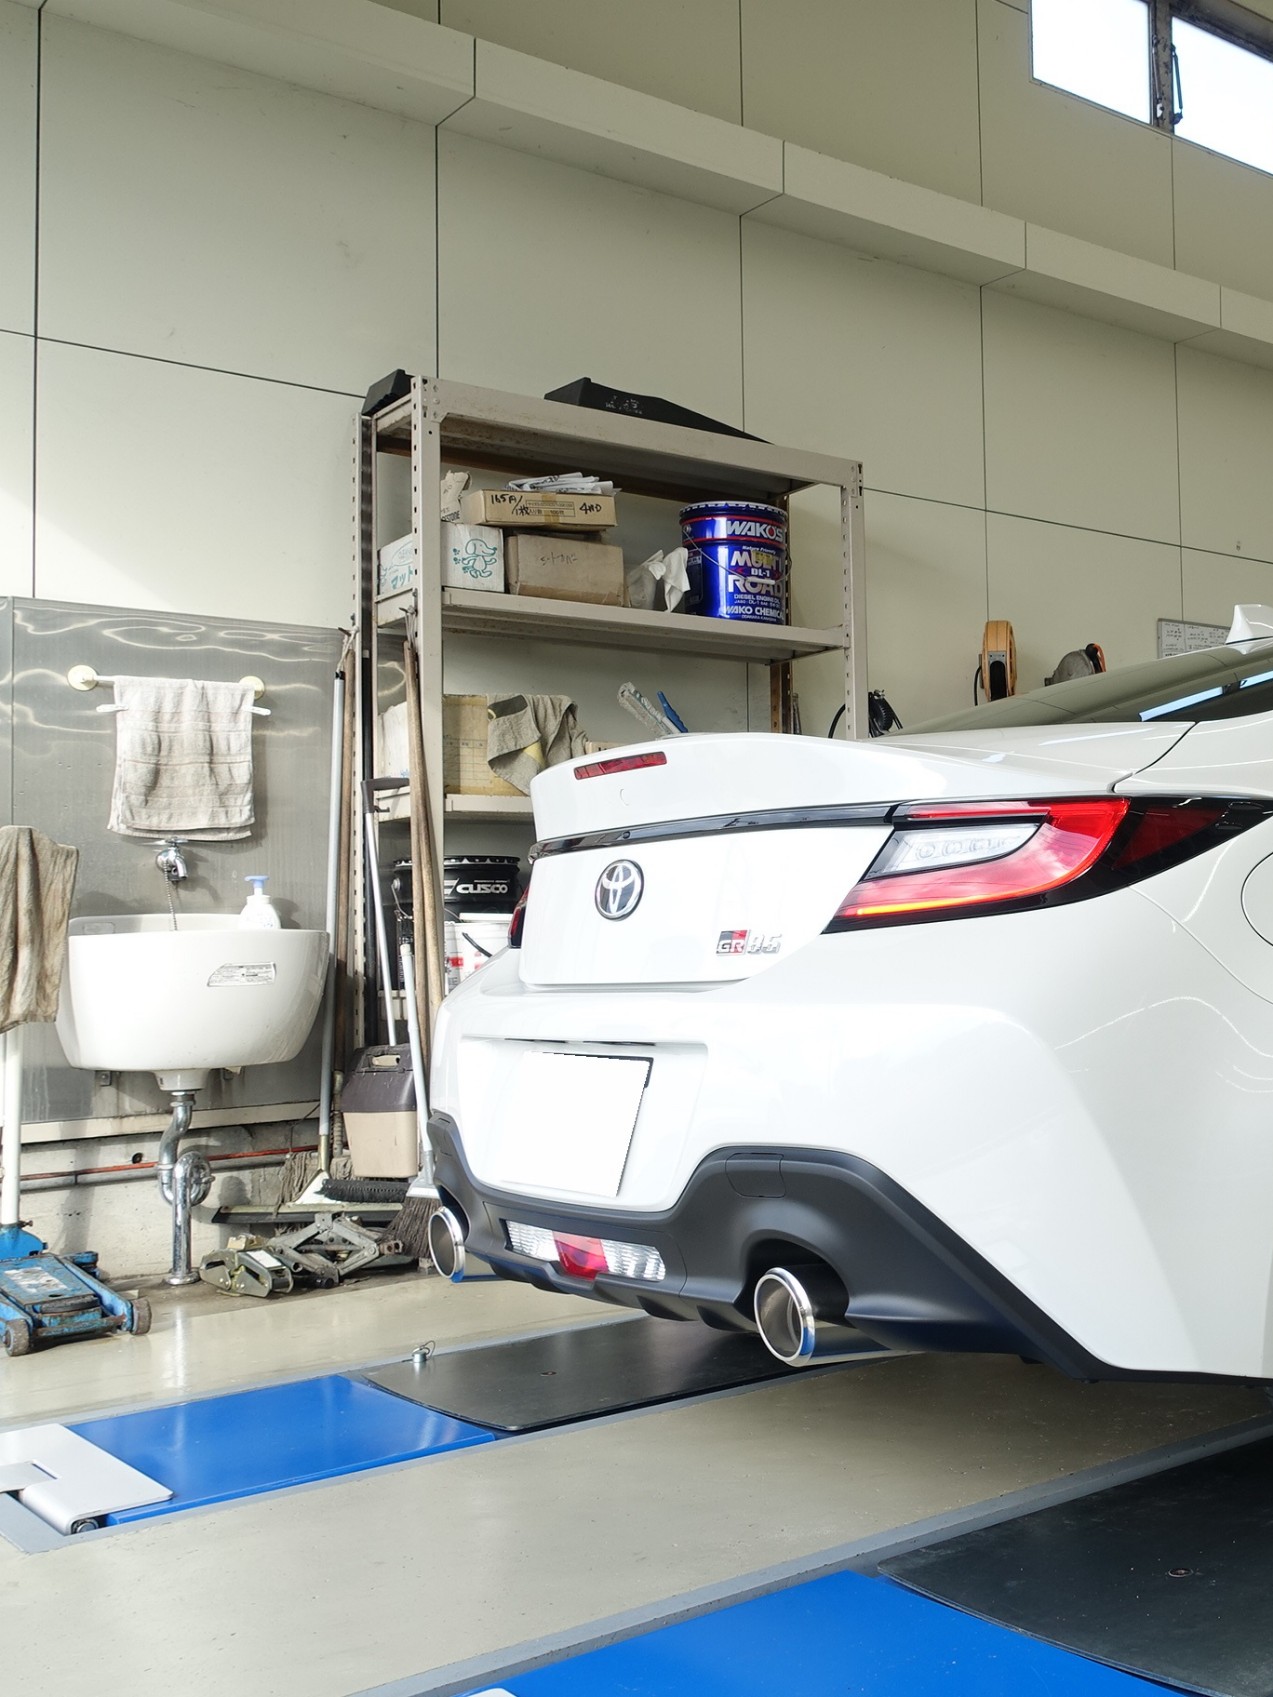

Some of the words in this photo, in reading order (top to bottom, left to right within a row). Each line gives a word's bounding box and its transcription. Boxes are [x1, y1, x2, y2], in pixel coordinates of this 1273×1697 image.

[751, 568, 770, 577] DL-1
[755, 607, 785, 619] CHEMICA
[456, 884, 508, 894] CUSCO
